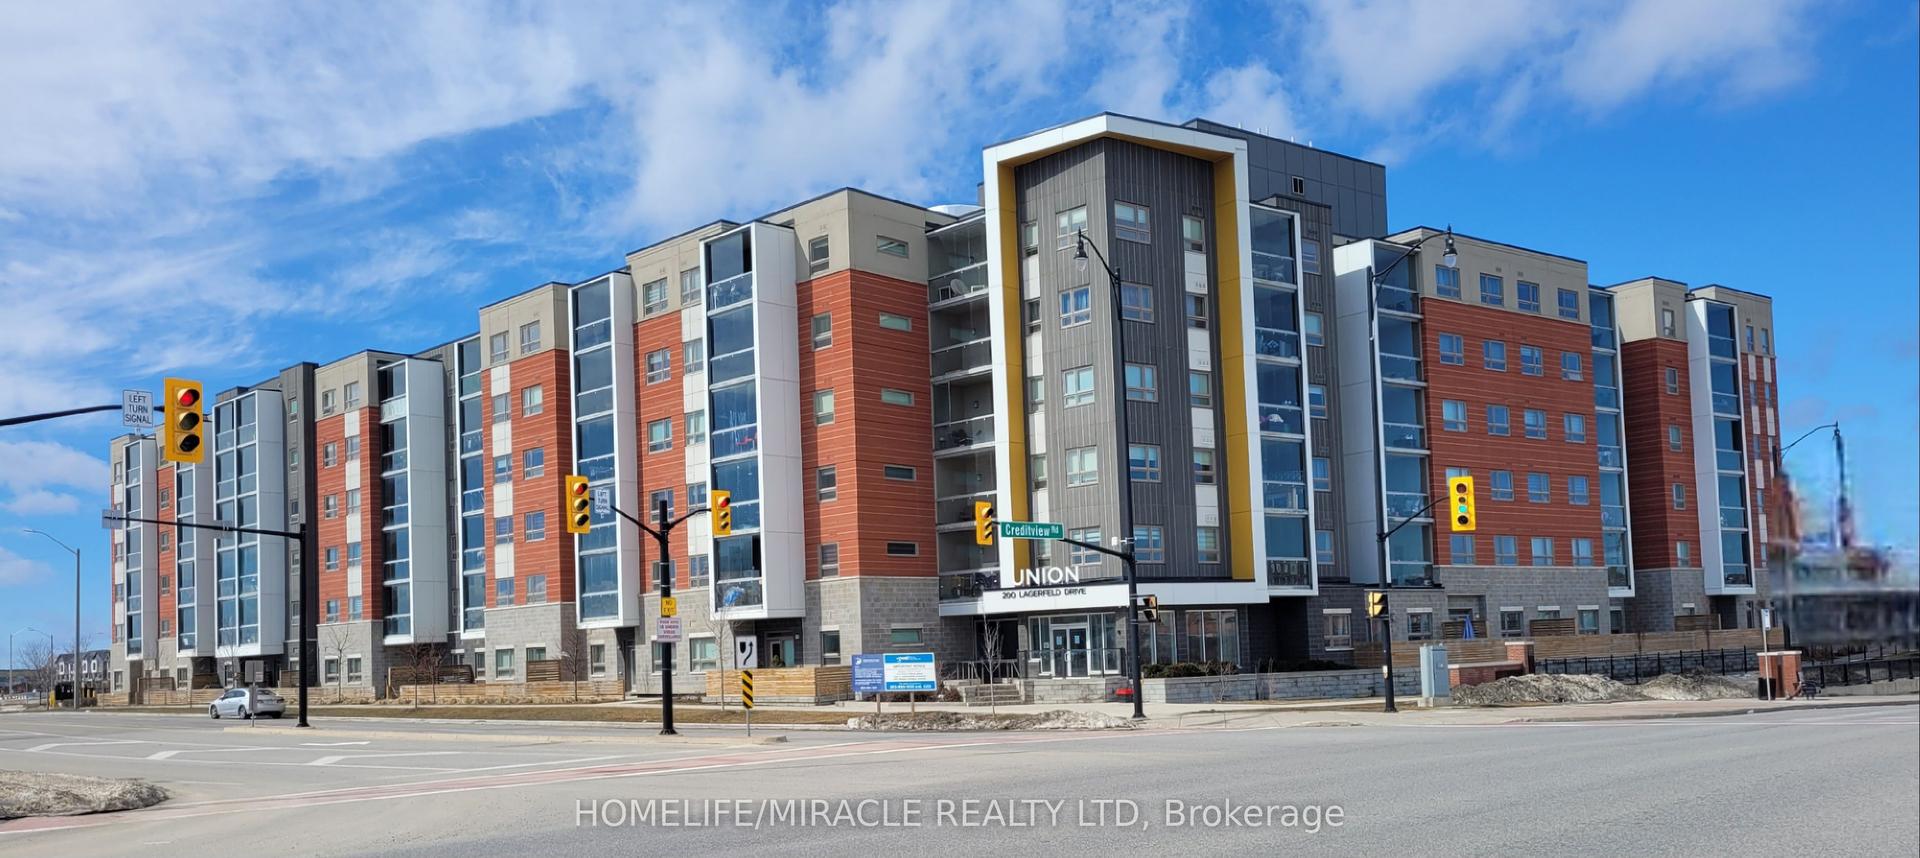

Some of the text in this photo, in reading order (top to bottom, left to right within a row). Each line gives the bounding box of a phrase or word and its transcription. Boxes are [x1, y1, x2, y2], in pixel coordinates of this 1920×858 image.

[129, 395, 146, 403] LEFT
[129, 404, 148, 413] TURN
[125, 414, 151, 424] SIGNAL
[1005, 524, 1059, 537] Creditview Rd
[1013, 566, 1079, 586] UNION
[1019, 589, 1061, 598] LAGERFELD
[1064, 588, 1086, 596] DRIVE
